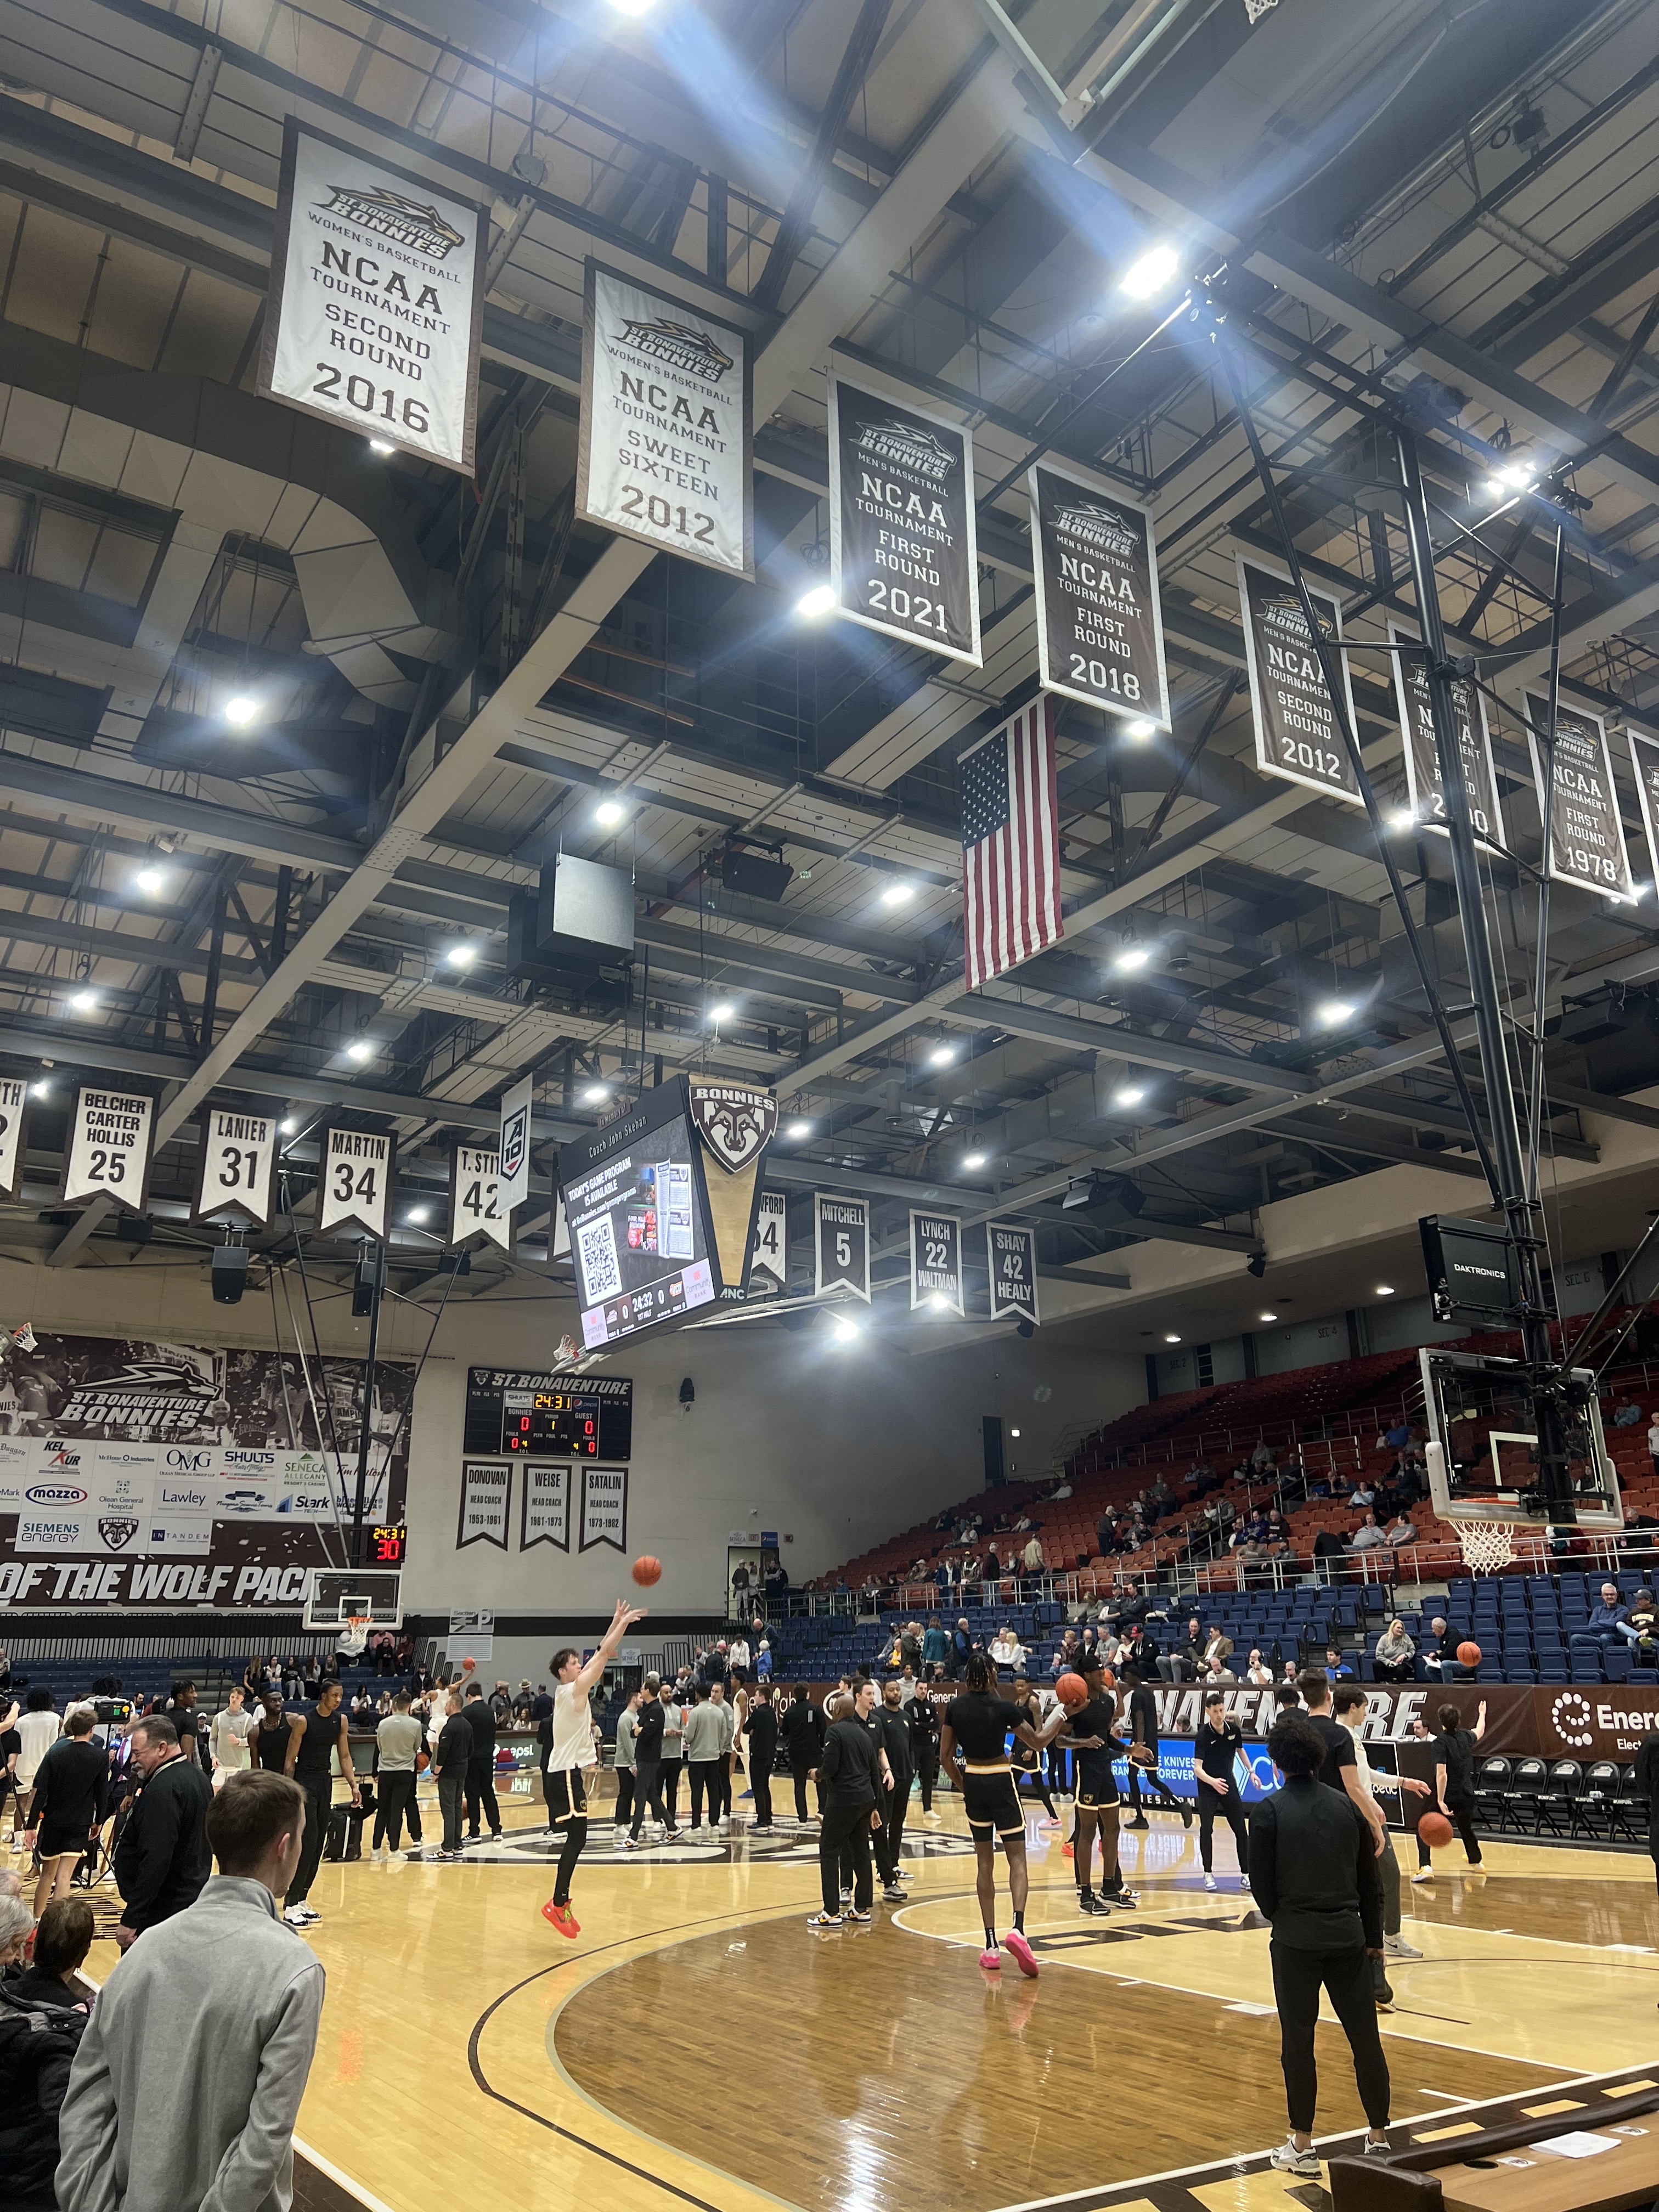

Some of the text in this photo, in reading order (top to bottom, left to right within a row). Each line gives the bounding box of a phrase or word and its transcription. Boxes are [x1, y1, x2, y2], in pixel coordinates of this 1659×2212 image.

[328, 201, 454, 259] BONNIES
[308, 211, 461, 284] WOMEN'S BASKETBALL
[321, 240, 442, 314] NCAA
[311, 267, 451, 334] TOURNAMENT
[325, 303, 431, 359] SECOND
[330, 329, 422, 380] ROUND
[623, 334, 725, 382] BONNIES
[608, 346, 732, 405] WOMEN'S BASKETBALL
[313, 362, 430, 433] 2016
[620, 371, 720, 434] NCAA
[613, 396, 726, 453] TOURNAMENT
[628, 430, 710, 473] SWEET
[861, 437, 946, 480] BONNIES
[619, 448, 718, 500] SIXTEEN
[858, 452, 949, 497] MEN'S BASKETBALL
[861, 472, 947, 528] NCAA
[621, 484, 714, 545] 2012
[856, 498, 953, 546] TOURNAMENT
[879, 529, 935, 563] FIRST
[1059, 518, 1131, 556] BONNIES
[1056, 534, 1136, 572] MEN'S BASKETBALL
[874, 549, 940, 586] ROUND
[1060, 553, 1135, 602] NCAA
[868, 579, 949, 633] 2021
[1057, 577, 1142, 619] TOURNAMENT
[1077, 607, 1125, 636] FIRST
[1264, 625, 1285, 640] MEN'S
[1074, 625, 1131, 658] ROUND
[1070, 653, 1140, 701] 2018
[1267, 665, 1331, 700] TOURNAMEN
[1278, 691, 1332, 723] SECOND
[1283, 710, 1331, 740] ROUND
[1282, 736, 1341, 779] 2012
[1564, 754, 1599, 772] BASKETBALL
[1554, 763, 1602, 798] NCAA
[1553, 782, 1607, 811] TOURNAMENT
[1566, 808, 1599, 828] FIRST
[1567, 823, 1606, 846] ROUND
[1567, 847, 1616, 882] 1978
[85, 1093, 145, 1115] BELCHER
[695, 1088, 775, 1111] BONNIES
[86, 1110, 140, 1131] CARTER
[605, 1108, 620, 1124] Memory
[621, 1103, 627, 1113] of
[87, 1128, 134, 1147] HOLLIS
[218, 1115, 267, 1142] LANIER
[589, 1116, 646, 1158] Coach John Skehan
[332, 1133, 385, 1160] MARTIN
[505, 1140, 522, 1163] 10
[88, 1150, 126, 1183] 25
[219, 1147, 258, 1189] 31
[462, 1150, 471, 1171] T.
[334, 1163, 376, 1204] 34
[568, 1156, 631, 1201] TODAY'S GAME PROGRAM
[463, 1181, 502, 1219] 42
[584, 1179, 618, 1206] IS AVAILABLE
[572, 1218, 577, 1227] at
[822, 1204, 864, 1226] MITCHELL
[921, 1220, 950, 1240] LYNCH
[836, 1232, 851, 1266] 5
[996, 1233, 1026, 1252] SHAY
[926, 1242, 947, 1269] 22
[1003, 1255, 1023, 1280] 42
[1454, 1263, 1506, 1279] DAKTRONICS
[686, 1278, 712, 1294] Community
[917, 1269, 957, 1291] WALTMAN
[997, 1282, 1031, 1301] HEALY
[632, 1291, 653, 1312] 24:32
[658, 1289, 664, 1305] 0
[695, 1290, 706, 1299] BANK
[720, 1288, 745, 1300] ANC
[622, 1305, 628, 1319] 0
[643, 1309, 652, 1318] HALF
[535, 1394, 570, 1409] 24:31
[55, 1404, 200, 1427] BONNIES
[521, 1417, 529, 1431] 0
[552, 1420, 555, 1430] 1
[585, 1420, 593, 1435] 0
[1, 1443, 26, 1455] Duggan
[43, 1441, 69, 1451] KEL
[511, 1438, 518, 1449] 0
[589, 1441, 595, 1453] 0
[167, 1449, 212, 1471] OMG
[225, 1452, 274, 1463] SHULTS
[285, 1463, 326, 1472] SENECA
[469, 1470, 506, 1485] DONOVAN
[535, 1473, 561, 1487] WEISE
[589, 1475, 621, 1489] SATALIN
[33, 1489, 80, 1499] mazza
[163, 1489, 206, 1506] Lawley
[295, 1496, 330, 1508] Stark
[470, 1495, 501, 1504] HEAD COACH
[532, 1498, 544, 1506] HEAD
[21, 1532, 78, 1543] energy
[23, 1523, 79, 1533] SIEMENS
[373, 1528, 404, 1539] 24:31
[377, 1539, 399, 1560] 30
[0, 1562, 323, 1601] OF THE WOLF PACK
[477, 1609, 491, 1630] P
[927, 1689, 958, 1703] General
[1164, 1756, 1195, 1768] KNIVES
